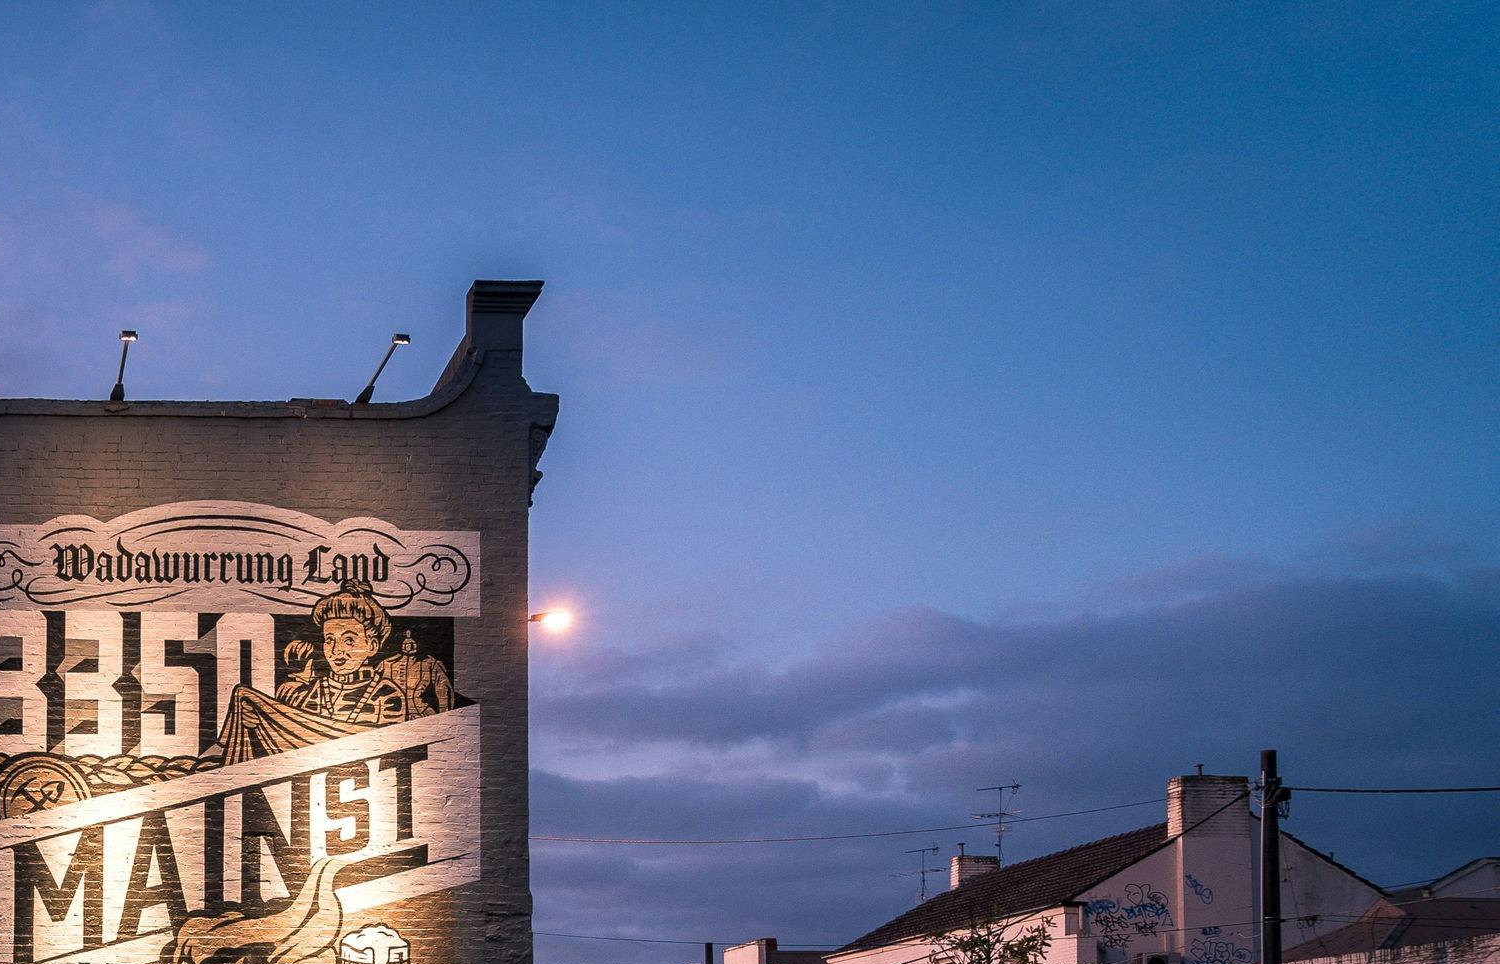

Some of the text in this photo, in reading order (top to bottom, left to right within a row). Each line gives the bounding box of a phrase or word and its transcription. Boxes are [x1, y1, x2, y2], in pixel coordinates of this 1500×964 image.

[50, 537, 390, 591] Wadawurrung Land
[324, 744, 430, 860] ST
